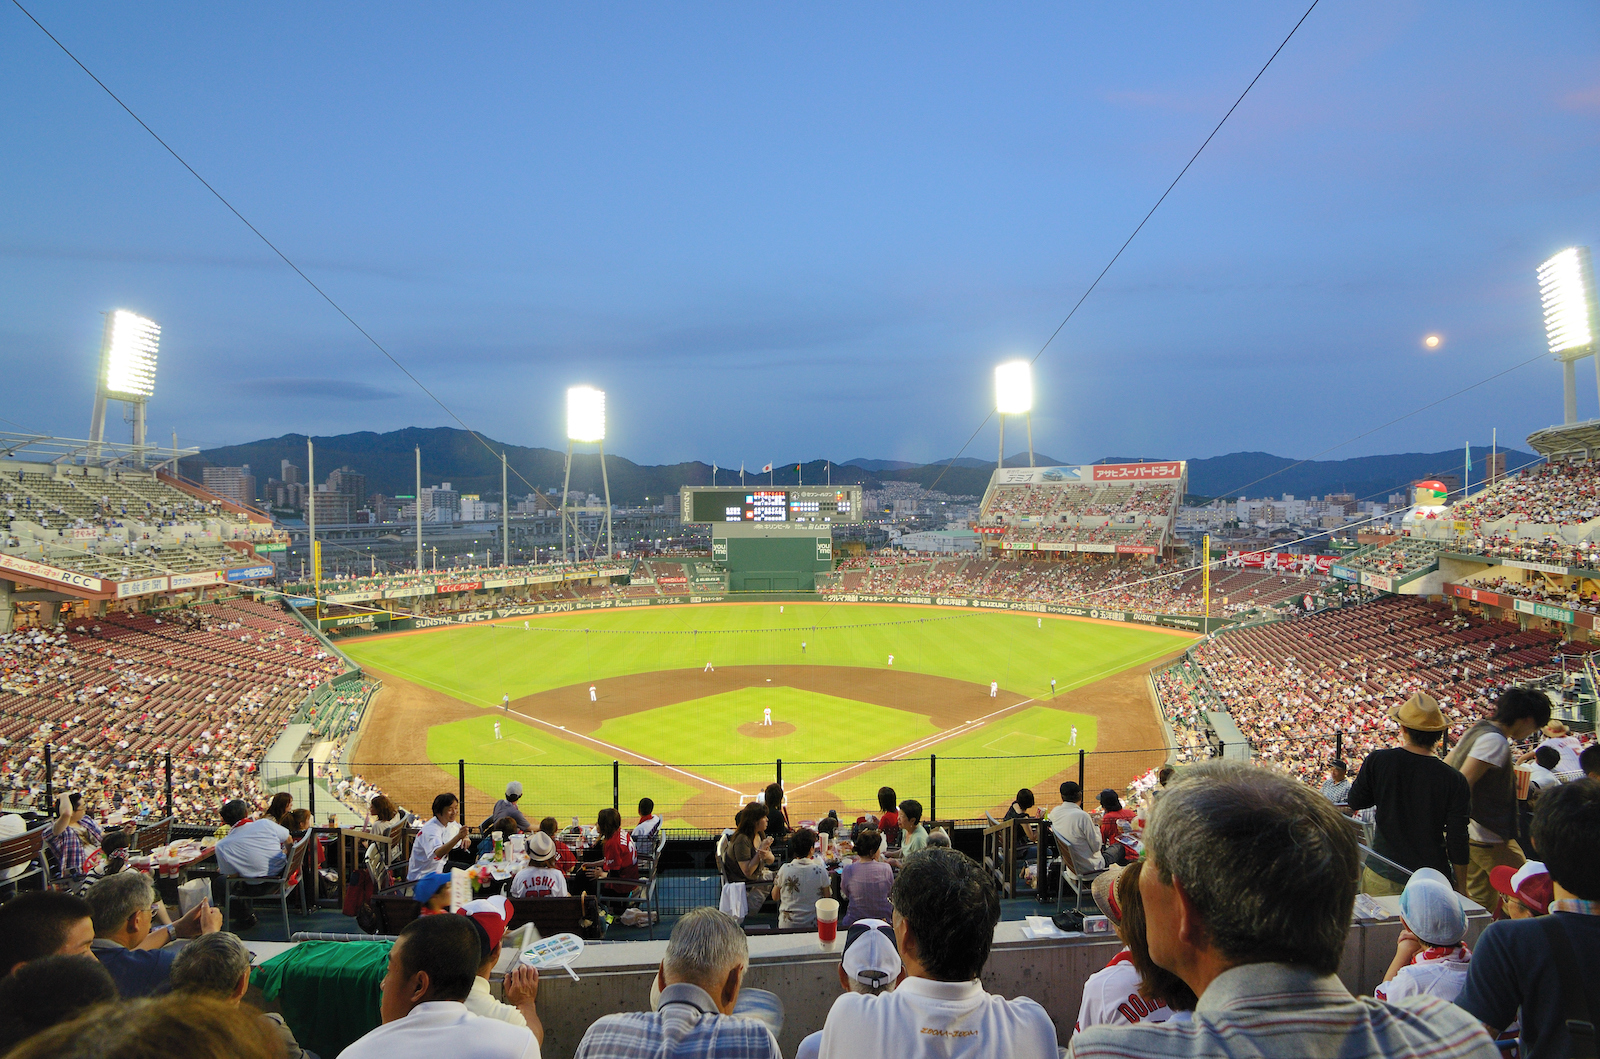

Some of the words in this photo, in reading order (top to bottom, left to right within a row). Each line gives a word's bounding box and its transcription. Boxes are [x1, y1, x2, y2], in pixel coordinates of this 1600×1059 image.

[61, 572, 92, 587] RCC
[121, 579, 163, 596] 聖教新聞
[980, 600, 1008, 609] SUZUKI
[1132, 613, 1158, 622] DUSKIN
[1535, 604, 1571, 622] 広島信用金庫
[415, 616, 453, 629] SUNSTAR
[522, 876, 556, 889] T.ISHII
[920, 1027, 979, 1038] ZOOM-ZOOM
